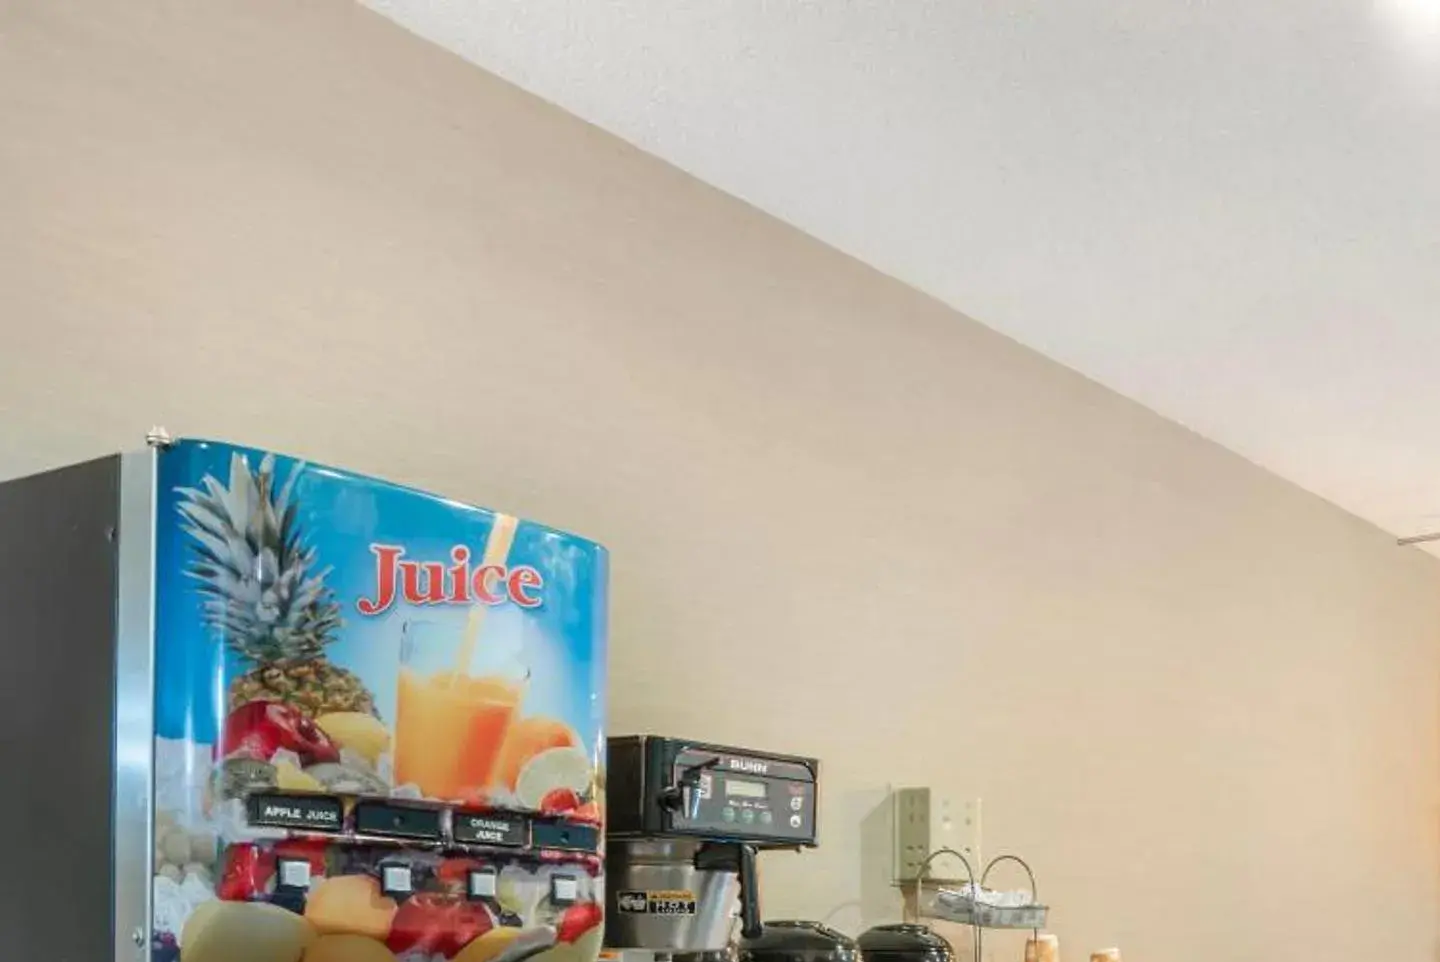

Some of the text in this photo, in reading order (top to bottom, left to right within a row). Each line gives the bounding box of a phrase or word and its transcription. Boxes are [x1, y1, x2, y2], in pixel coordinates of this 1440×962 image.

[357, 543, 543, 615] Juice
[264, 805, 337, 821] APPLE JUICE
[470, 818, 510, 832] ORANGE
[475, 830, 504, 841] JUICE
